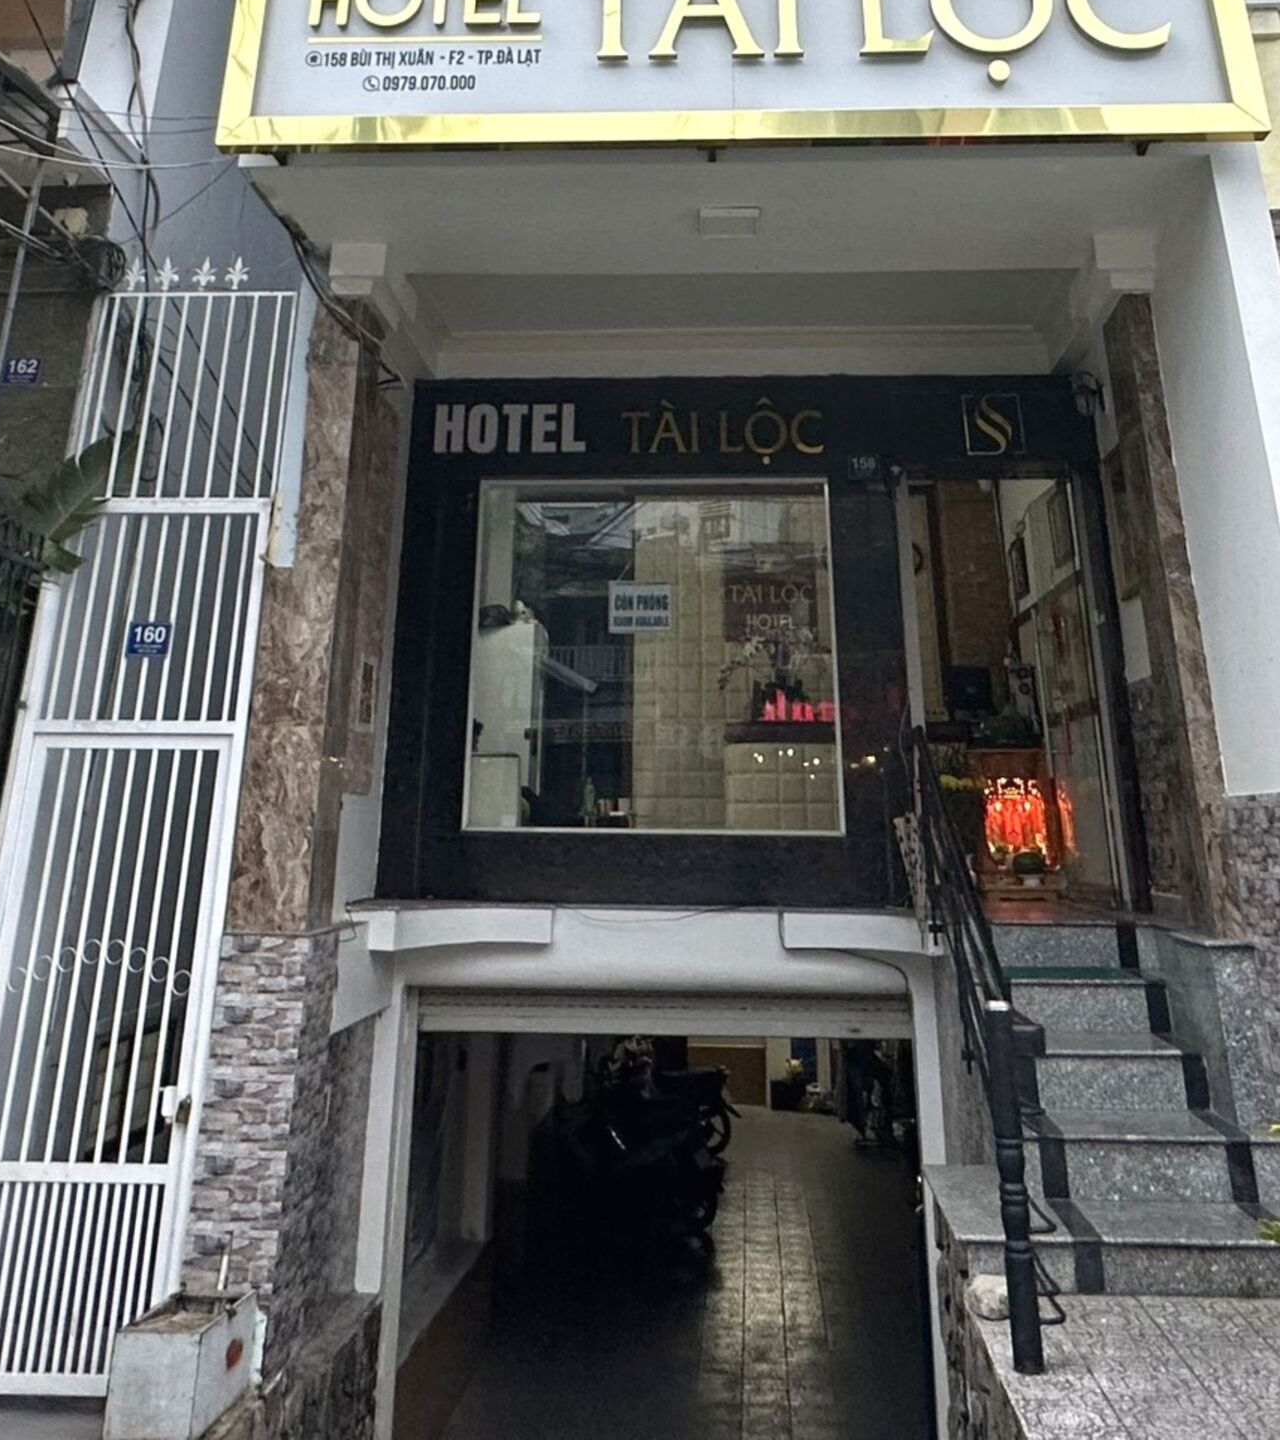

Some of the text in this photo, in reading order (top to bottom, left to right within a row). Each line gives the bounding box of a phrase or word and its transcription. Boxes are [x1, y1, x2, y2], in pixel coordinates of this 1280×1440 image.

[323, 51, 347, 68] 158
[350, 48, 371, 68] BÙI
[375, 50, 396, 69] THỊ
[400, 48, 434, 66] XUÂN
[448, 50, 466, 65] F2
[517, 49, 542, 68] LẠT
[382, 74, 476, 92] 0979.070.000
[9, 359, 39, 374] 162
[432, 402, 587, 456] HOTEL
[620, 397, 702, 456] TÀI
[718, 396, 826, 466] LỘC
[134, 626, 167, 643] 160
